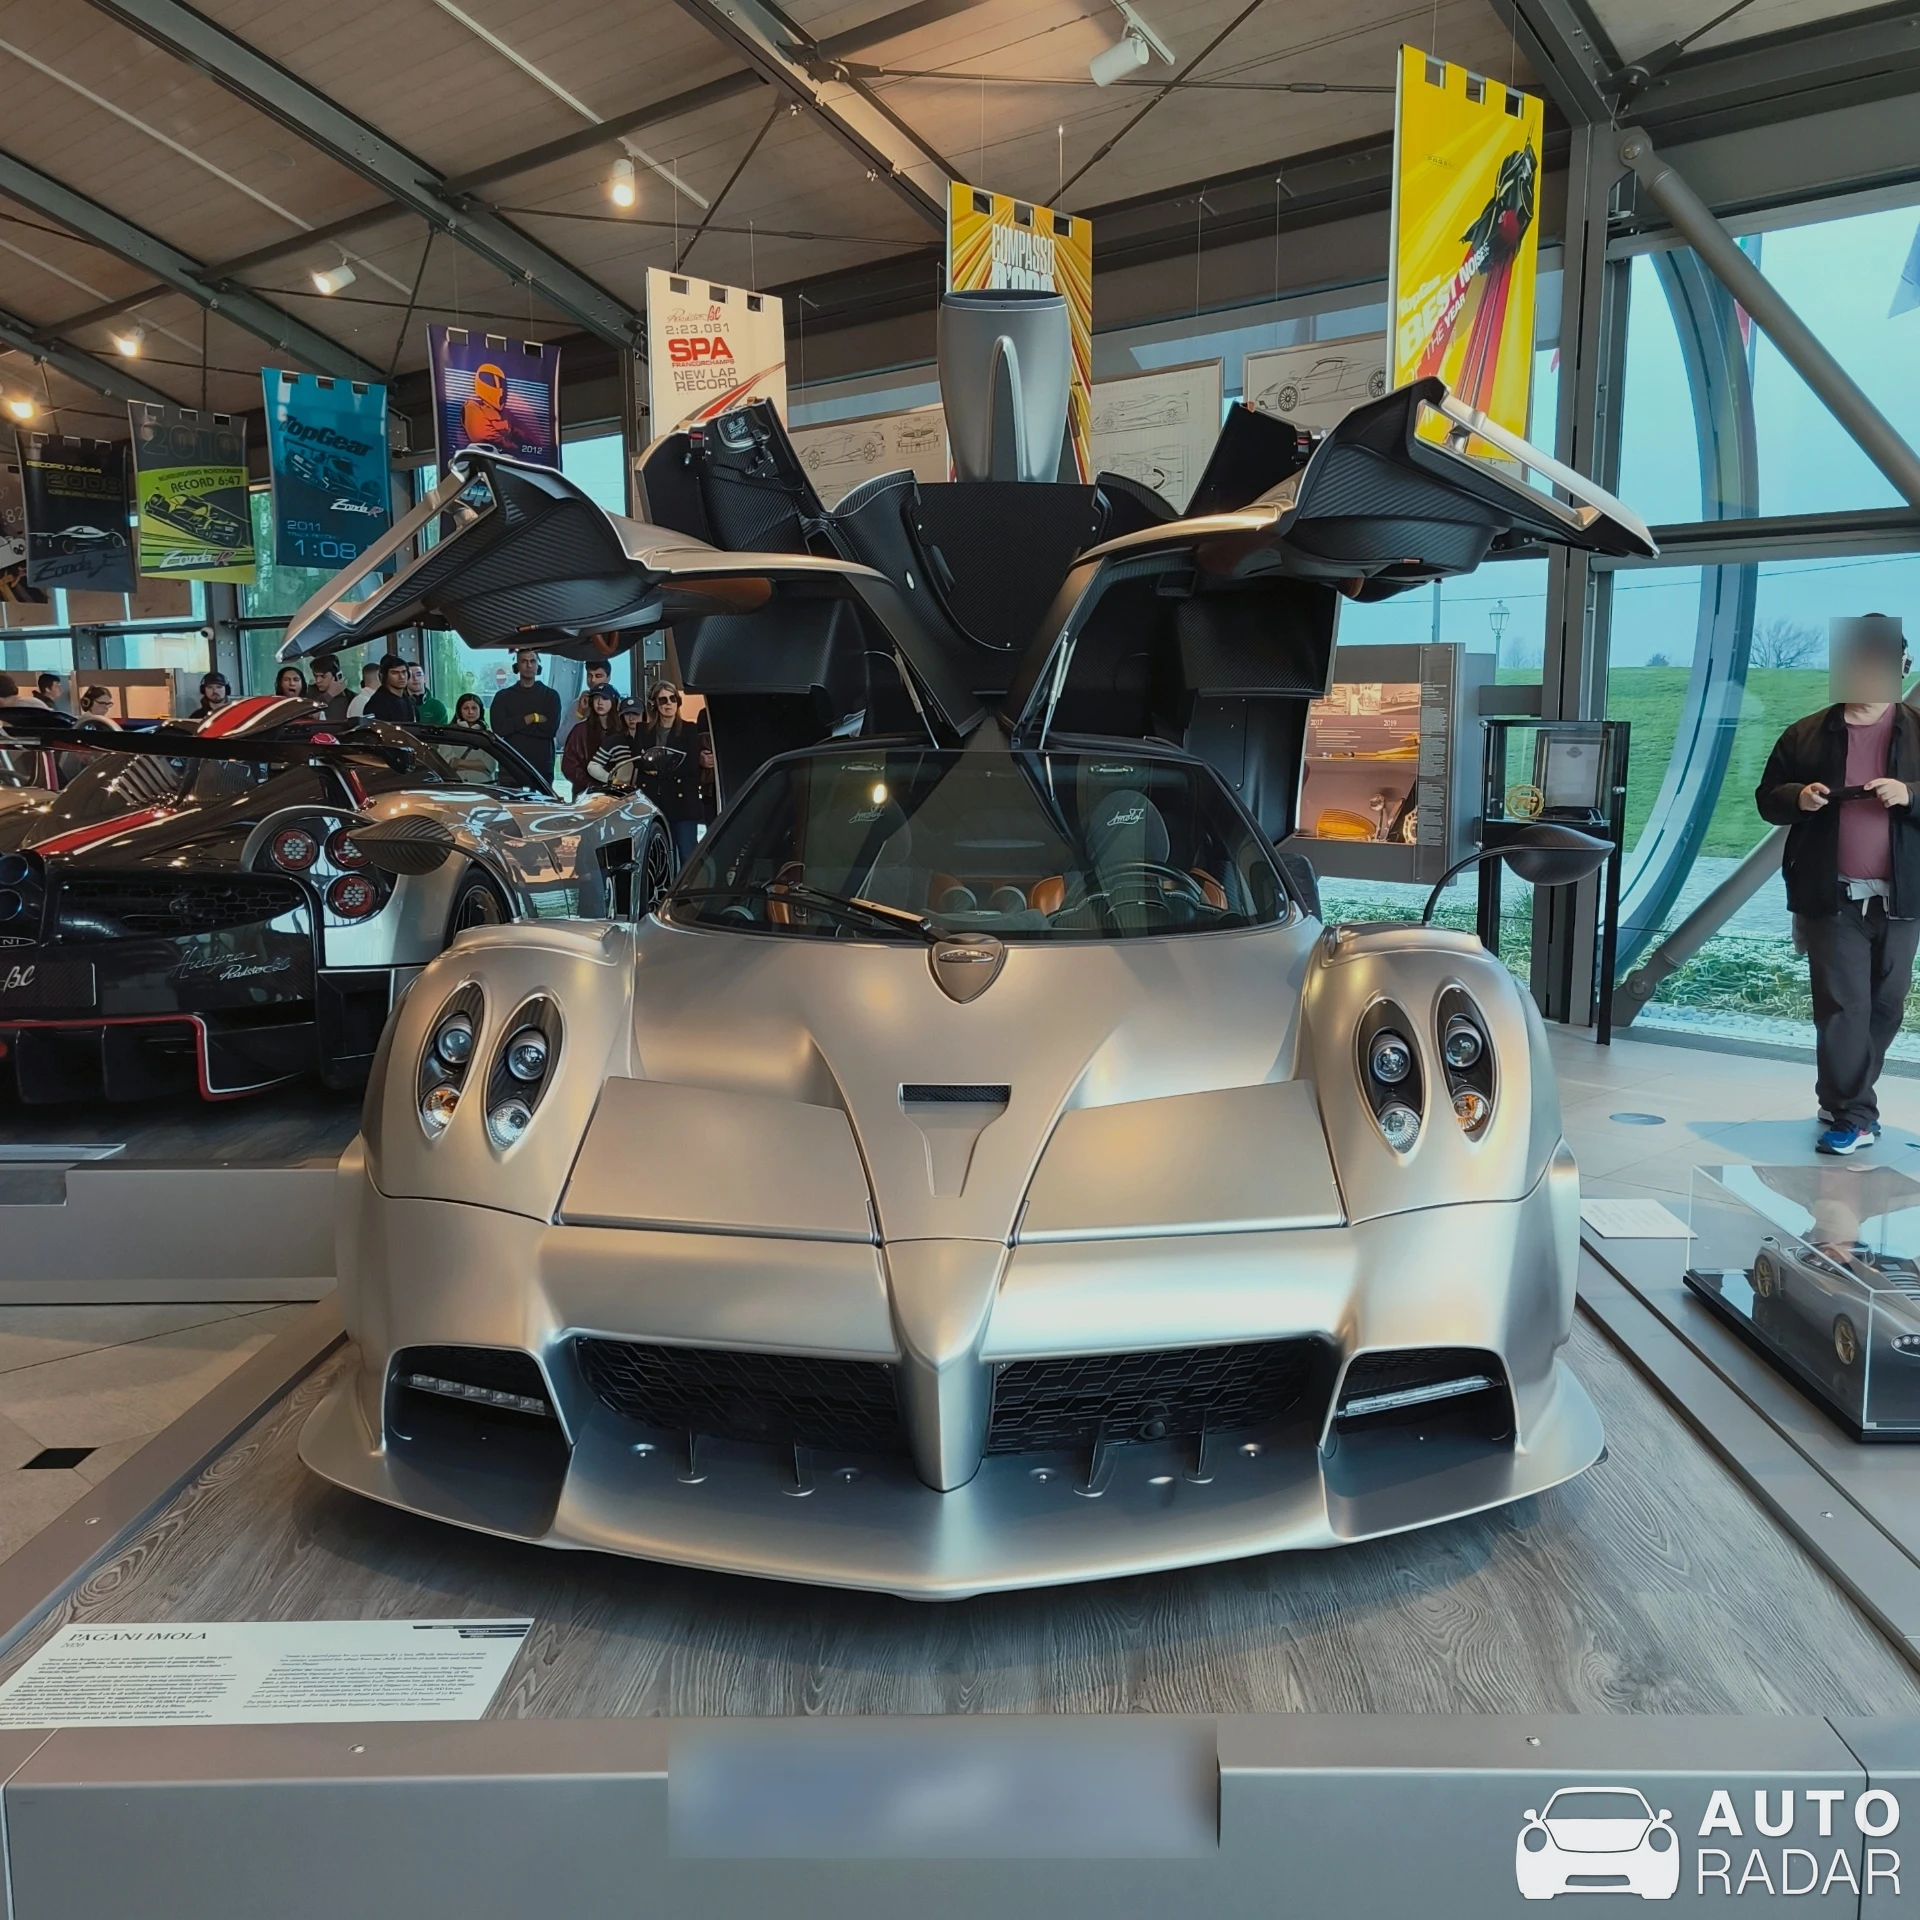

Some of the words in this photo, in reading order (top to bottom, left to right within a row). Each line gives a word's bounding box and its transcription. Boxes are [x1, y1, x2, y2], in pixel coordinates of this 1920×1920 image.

[992, 223, 1055, 276] COMPASSO
[1399, 276, 1458, 367] BEST
[1425, 324, 1445, 360] THE
[1443, 293, 1466, 328] YEAR
[668, 336, 733, 362] SPA
[671, 358, 735, 369] FRANCORCHAMPS
[673, 369, 706, 381] NEW
[710, 367, 737, 378] LAP
[675, 377, 739, 392] RECORD
[141, 422, 240, 464] 2010
[521, 445, 543, 454] 2012
[47, 472, 122, 494] 2008
[170, 477, 215, 493] RECORD
[218, 475, 241, 486] 6:47
[287, 520, 321, 531] 2011
[159, 548, 213, 568] Zonda
[211, 551, 237, 566] R
[170, 946, 258, 979] Huayra
[3, 965, 36, 992] BC
[219, 964, 271, 982] Roadster
[68, 1633, 143, 1641] PAGANI
[143, 1632, 207, 1640] IMOLA
